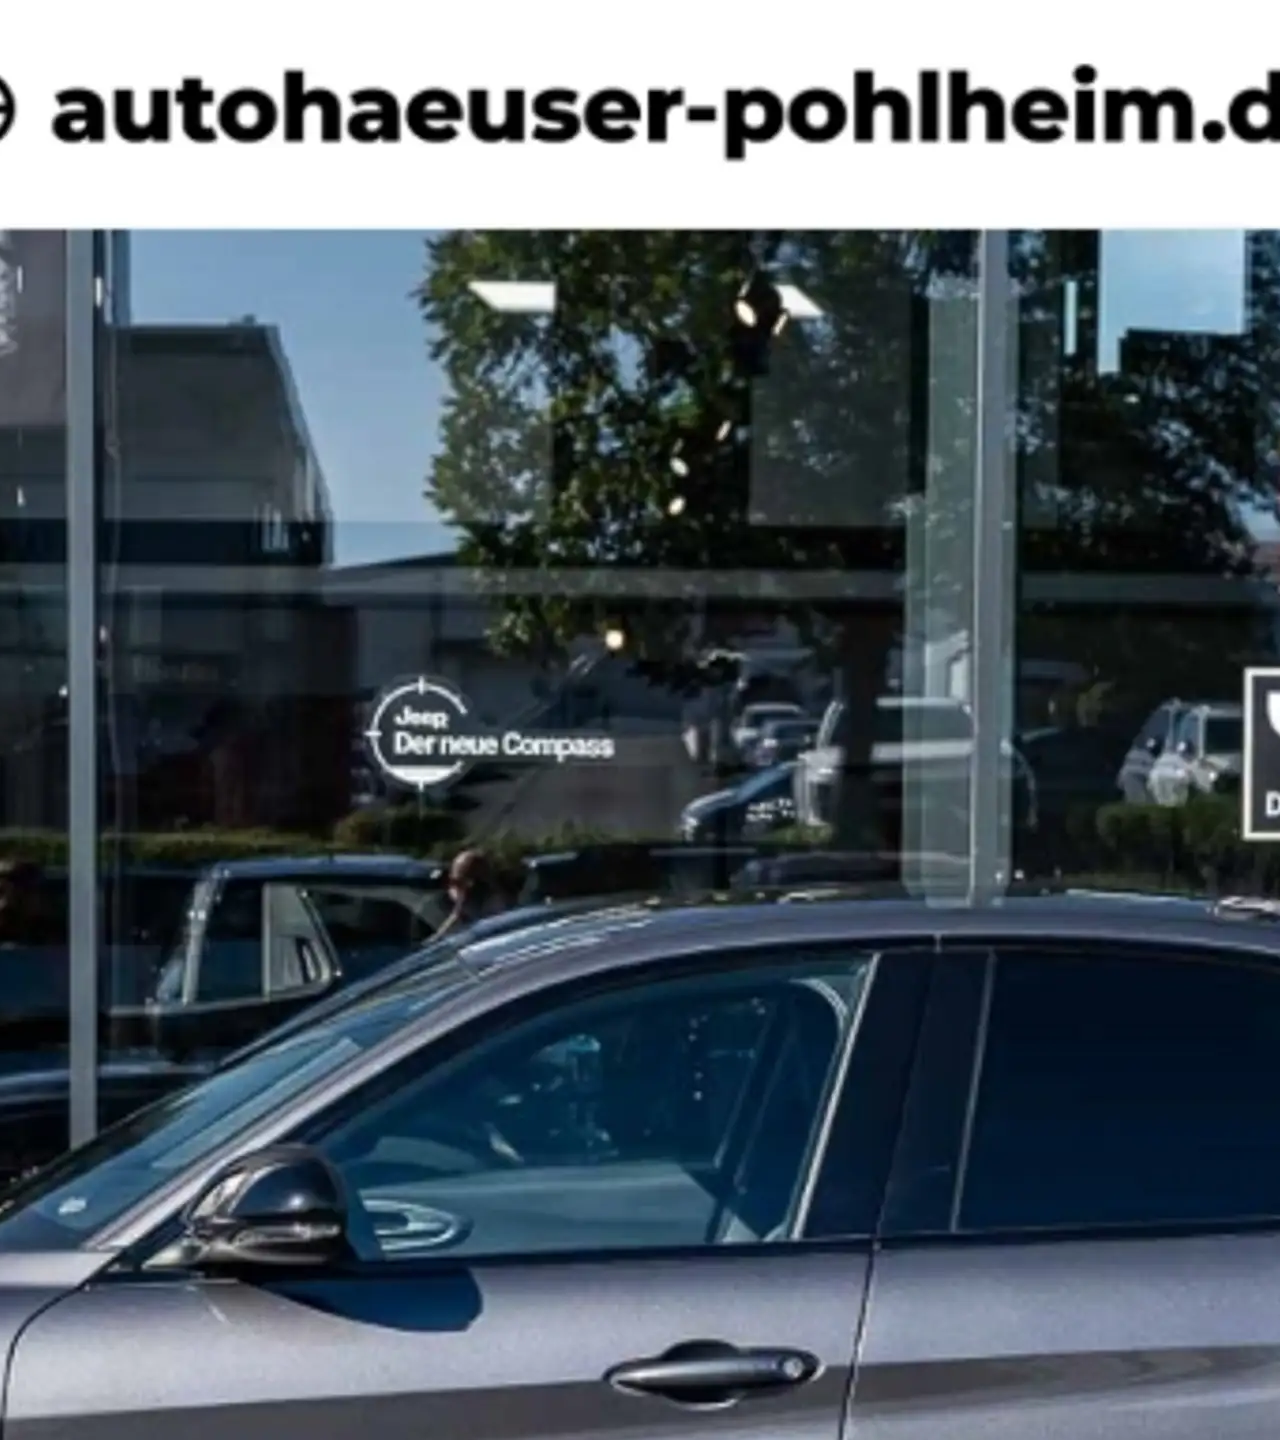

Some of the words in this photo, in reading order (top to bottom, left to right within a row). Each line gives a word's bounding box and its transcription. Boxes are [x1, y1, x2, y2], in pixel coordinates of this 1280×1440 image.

[393, 705, 450, 730] Jeep
[394, 731, 437, 755] Der
[439, 735, 500, 756] neue
[502, 731, 616, 764] Compass
